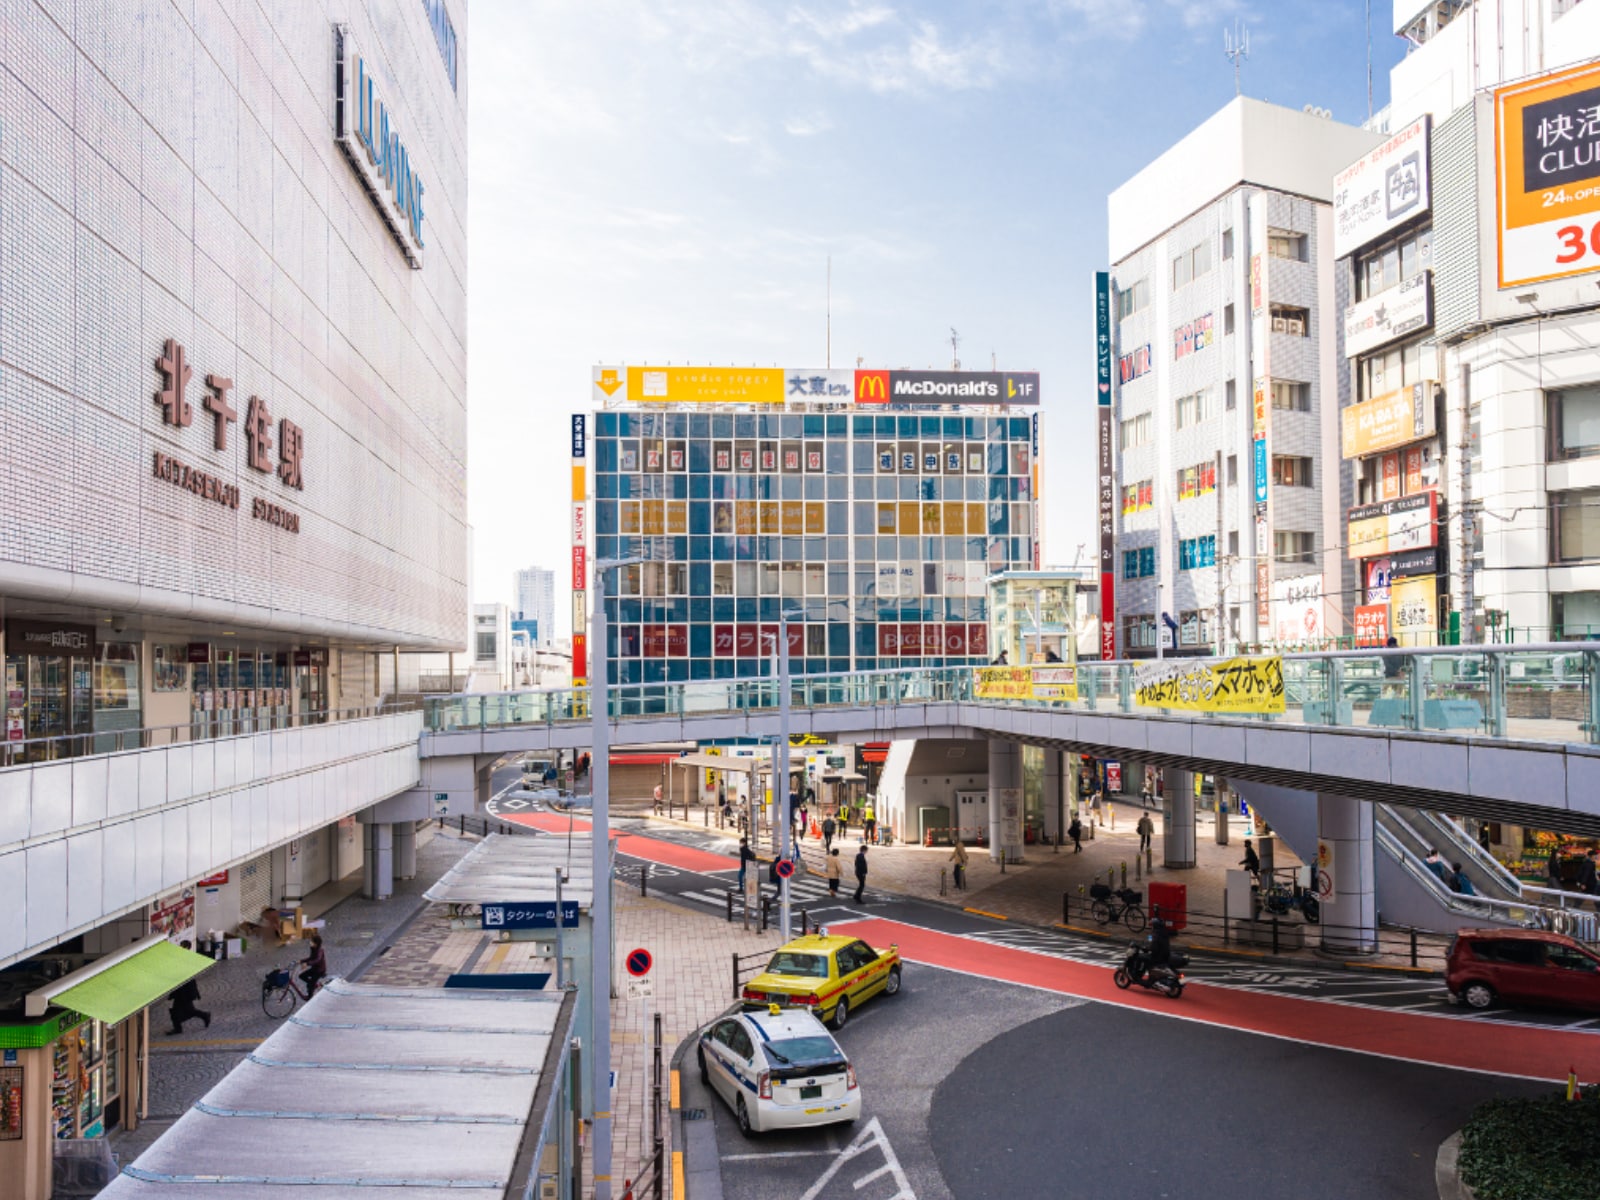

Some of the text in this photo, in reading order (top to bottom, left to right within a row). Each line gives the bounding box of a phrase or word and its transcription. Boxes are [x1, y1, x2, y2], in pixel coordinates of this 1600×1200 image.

[1537, 106, 1600, 148] 快活
[353, 53, 425, 249] LUMINE
[1539, 141, 1600, 175] CLU
[1099, 334, 1109, 378] キレイモ
[788, 375, 851, 397] 大東ビル
[894, 380, 999, 397] McDonald's
[1018, 383, 1034, 396] 1F
[154, 337, 305, 492] 北千住駅
[154, 451, 300, 535] KITASENJU STATION
[1381, 502, 1394, 515] 4F
[1356, 611, 1386, 626] カラオケ
[716, 632, 802, 648] カラオケ
[506, 910, 575, 921] タクシーのば
